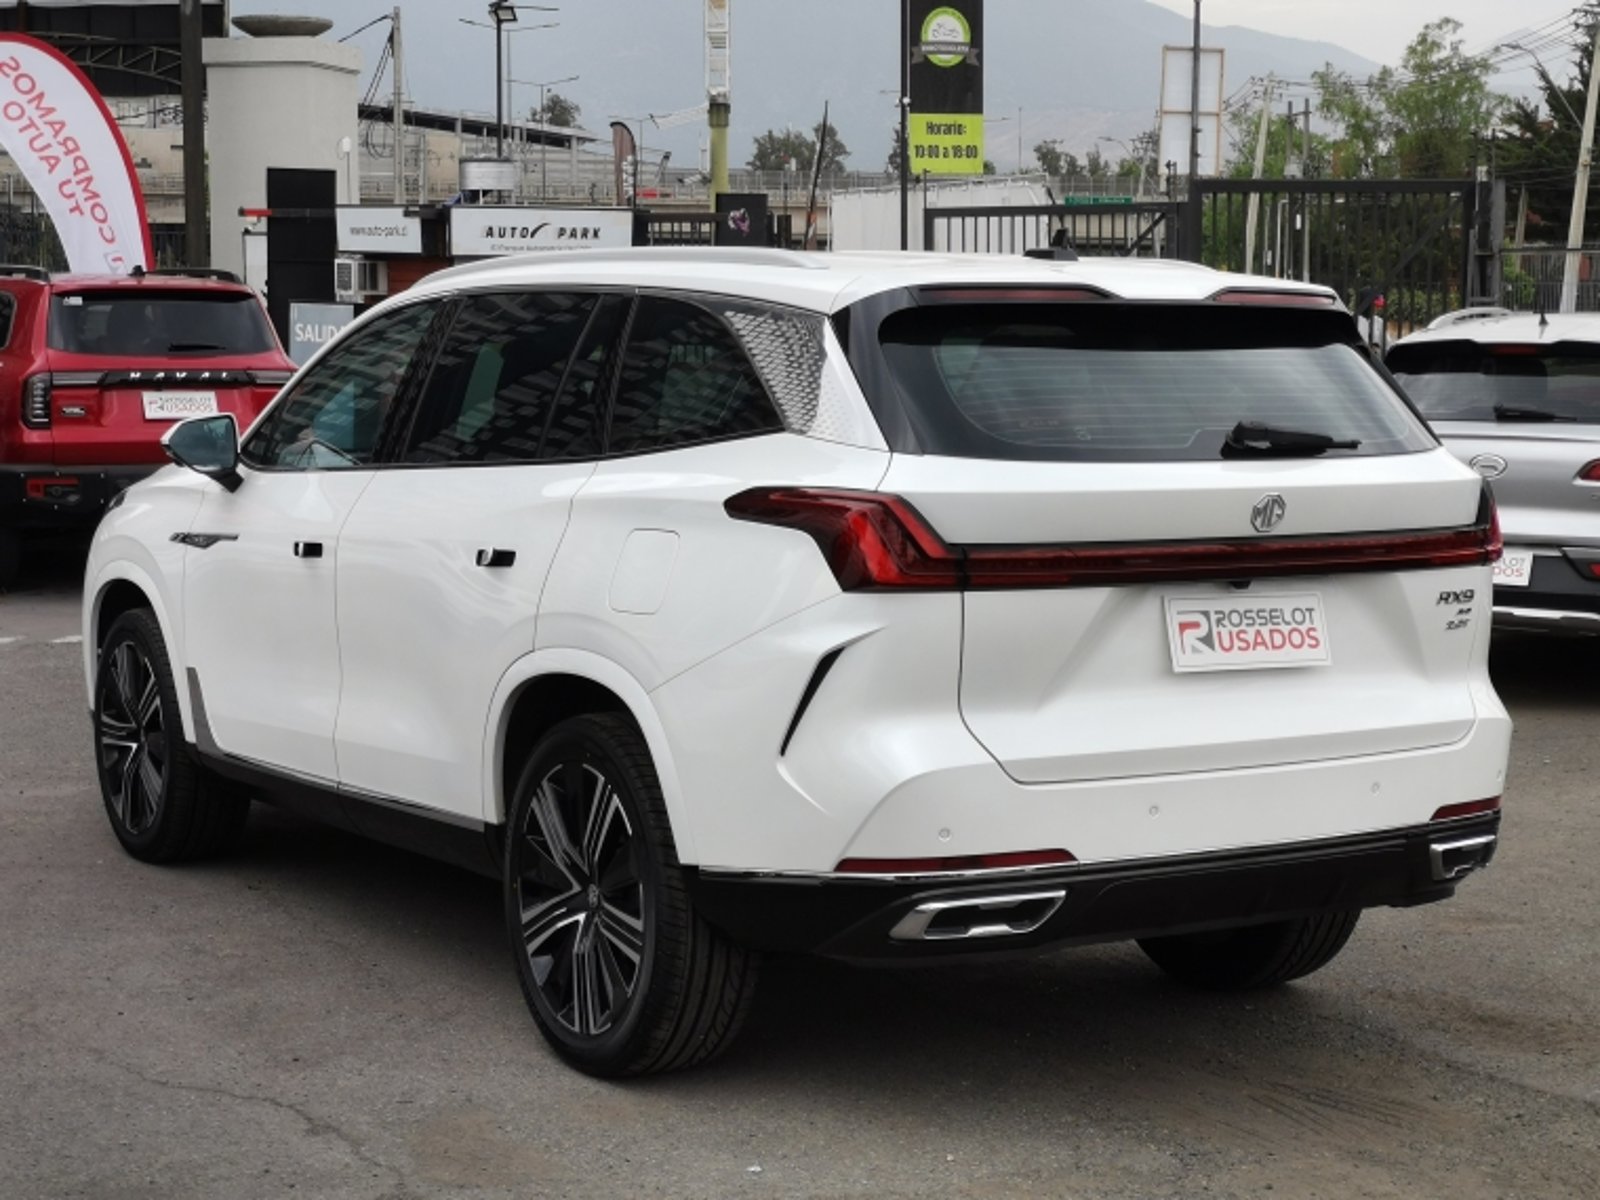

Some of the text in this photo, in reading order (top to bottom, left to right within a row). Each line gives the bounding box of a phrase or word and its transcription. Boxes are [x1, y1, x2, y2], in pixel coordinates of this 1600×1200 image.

[926, 121, 967, 135] Horario:
[914, 145, 940, 158] 10:00
[485, 226, 601, 239] AUTO PARK
[294, 323, 346, 342] SALID
[129, 371, 229, 380] HAVAL
[1251, 493, 1286, 532] MG
[1492, 565, 1524, 577] DOS
[1437, 589, 1475, 605] RX9
[1214, 607, 1315, 628] ROSSELOT
[1216, 627, 1320, 653] USADOS
